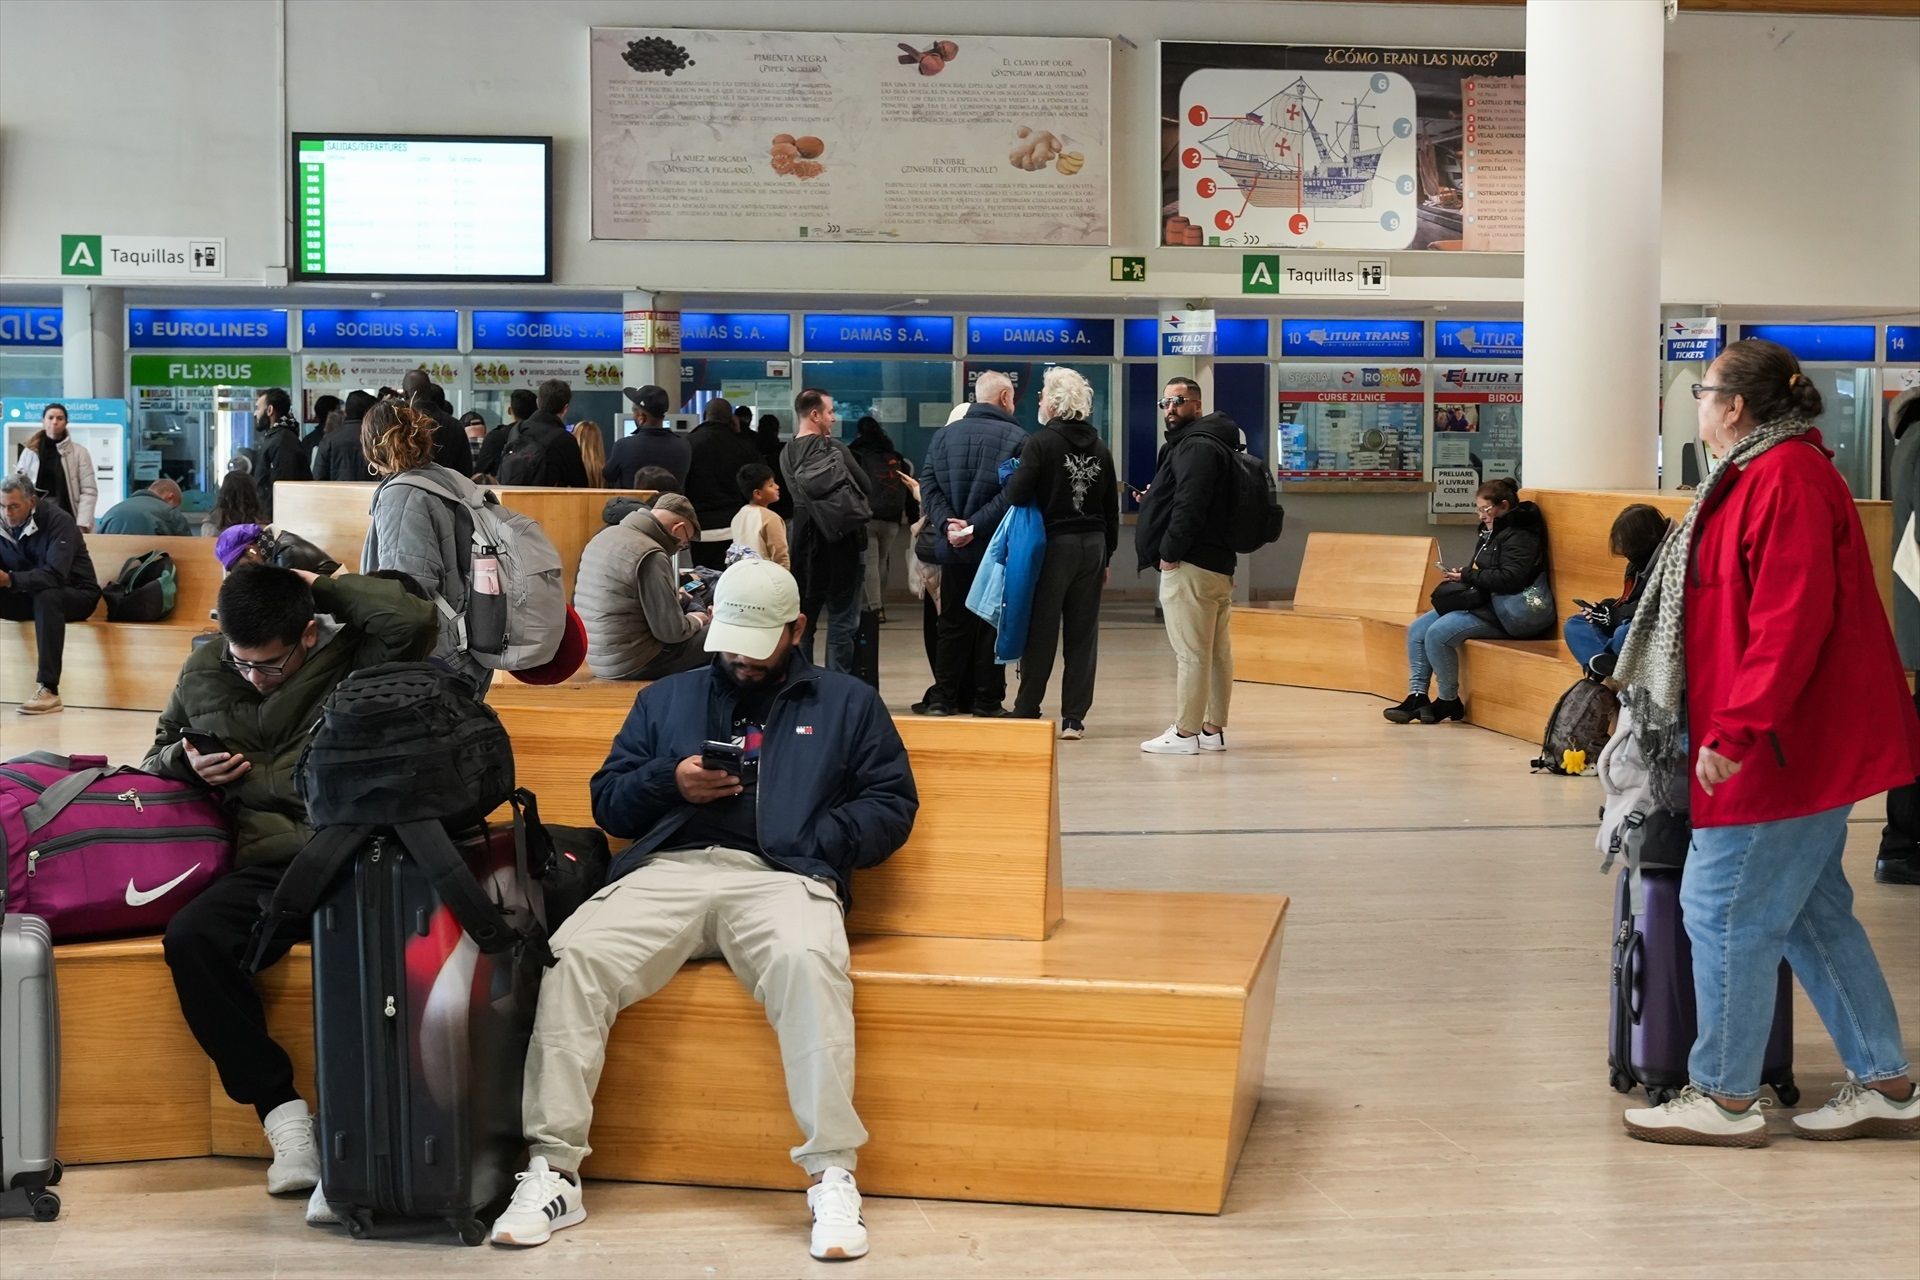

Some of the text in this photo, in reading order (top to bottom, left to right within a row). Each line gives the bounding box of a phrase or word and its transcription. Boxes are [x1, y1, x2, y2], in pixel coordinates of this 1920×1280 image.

[753, 53, 828, 63] PIMIENTA NEGRA
[1324, 47, 1499, 68] ¿CÓMO ERAN LAS NAOS?
[1377, 78, 1387, 91] 6
[1200, 111, 1206, 122] 1
[1403, 123, 1411, 134] 7
[326, 141, 408, 152] SALIDAS/DEPARTURES
[707, 154, 748, 163] MOSCADA
[1191, 152, 1200, 164] 2
[1207, 183, 1215, 193] 3
[1404, 180, 1412, 192] 8
[1224, 215, 1233, 227] 4
[1390, 217, 1398, 228] 9
[1298, 222, 1307, 233] 5
[110, 247, 185, 267] Taquillas
[1286, 267, 1354, 286] Taquillas
[0, 312, 63, 341] als
[134, 322, 269, 337] 3 EUROLINES
[307, 322, 442, 337] 4 SOCIBUS S.A.
[478, 323, 611, 339] 5 SOCIBUS S.A.
[733, 325, 766, 339] S.A.
[810, 327, 929, 342] 7 DAMAS S.A.
[972, 328, 1092, 344] 8 DAMAS S.A.
[1168, 334, 1207, 343] VENTA DE
[1288, 331, 1302, 345] 10
[1364, 331, 1410, 341] TRANS
[1441, 333, 1453, 346] 11
[1171, 344, 1203, 353] TICKETS
[1672, 340, 1709, 349] VENTA DE
[1892, 337, 1905, 350] 14
[1675, 350, 1705, 359] TICKETS
[529, 368, 581, 376] www.socibus.es
[1364, 373, 1417, 383] ROMANIA
[1317, 393, 1386, 401] CURSE ZILNICE
[1488, 394, 1523, 403] BIROU
